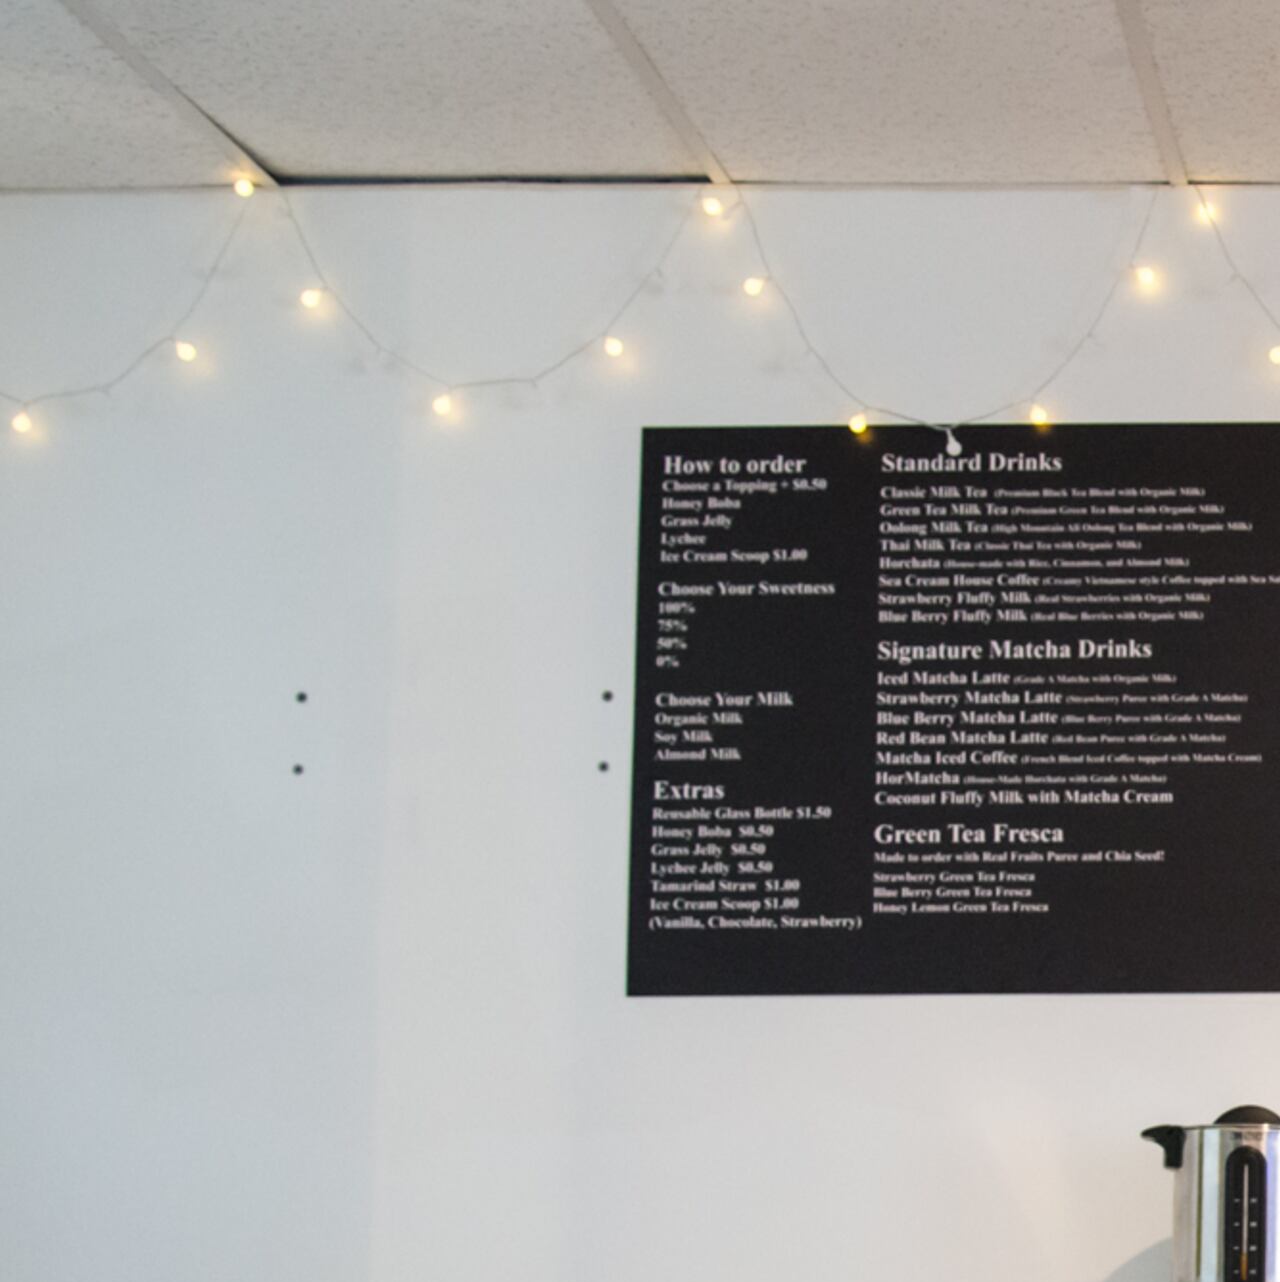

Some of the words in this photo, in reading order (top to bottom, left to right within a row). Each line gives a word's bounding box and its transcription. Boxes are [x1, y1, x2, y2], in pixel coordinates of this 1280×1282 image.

[664, 456, 713, 474] How
[720, 458, 741, 474] to
[746, 454, 807, 474] order
[882, 453, 981, 472] Standard
[989, 453, 1062, 471] Drinks
[880, 486, 926, 498] Classic
[930, 486, 961, 498] Milk
[965, 486, 987, 498] Tea
[879, 504, 921, 516] Green
[924, 503, 947, 516] Tea
[951, 503, 981, 515] Milk
[986, 503, 1008, 515] Tea
[878, 575, 902, 587] Sea
[905, 574, 950, 587] Cream
[953, 574, 994, 586] House
[997, 573, 1040, 586] Coffee
[658, 582, 714, 596] Choose
[717, 581, 755, 595] Your
[758, 581, 835, 595] Sweetness
[878, 592, 952, 607] Strawberry
[957, 592, 995, 606] Fluffy
[1001, 591, 1032, 604] Milk
[659, 602, 695, 614] 100%
[878, 641, 983, 665] Signature
[990, 640, 1071, 659] Matcha
[1078, 638, 1153, 659] Drinks
[877, 672, 908, 685] Iced
[913, 671, 968, 685] Matcha
[972, 671, 1010, 684] Latte
[655, 693, 711, 707] Choose
[715, 692, 753, 706] Your
[757, 692, 793, 706] Milk
[877, 691, 959, 707] Strawberry
[965, 691, 1020, 704] Matcha
[1024, 690, 1062, 704] Latte
[655, 748, 707, 760] Almond
[710, 748, 741, 760] Milk
[654, 780, 725, 800] Extras
[874, 791, 936, 805] Coconut
[940, 791, 983, 807] Fluffy
[990, 790, 1024, 804] Milk
[1027, 790, 1060, 804] with
[1065, 790, 1120, 803] Matcha
[1123, 790, 1173, 803] Cream
[874, 824, 941, 844] Green
[947, 824, 986, 843] Tea
[994, 824, 1064, 843] Fresca
